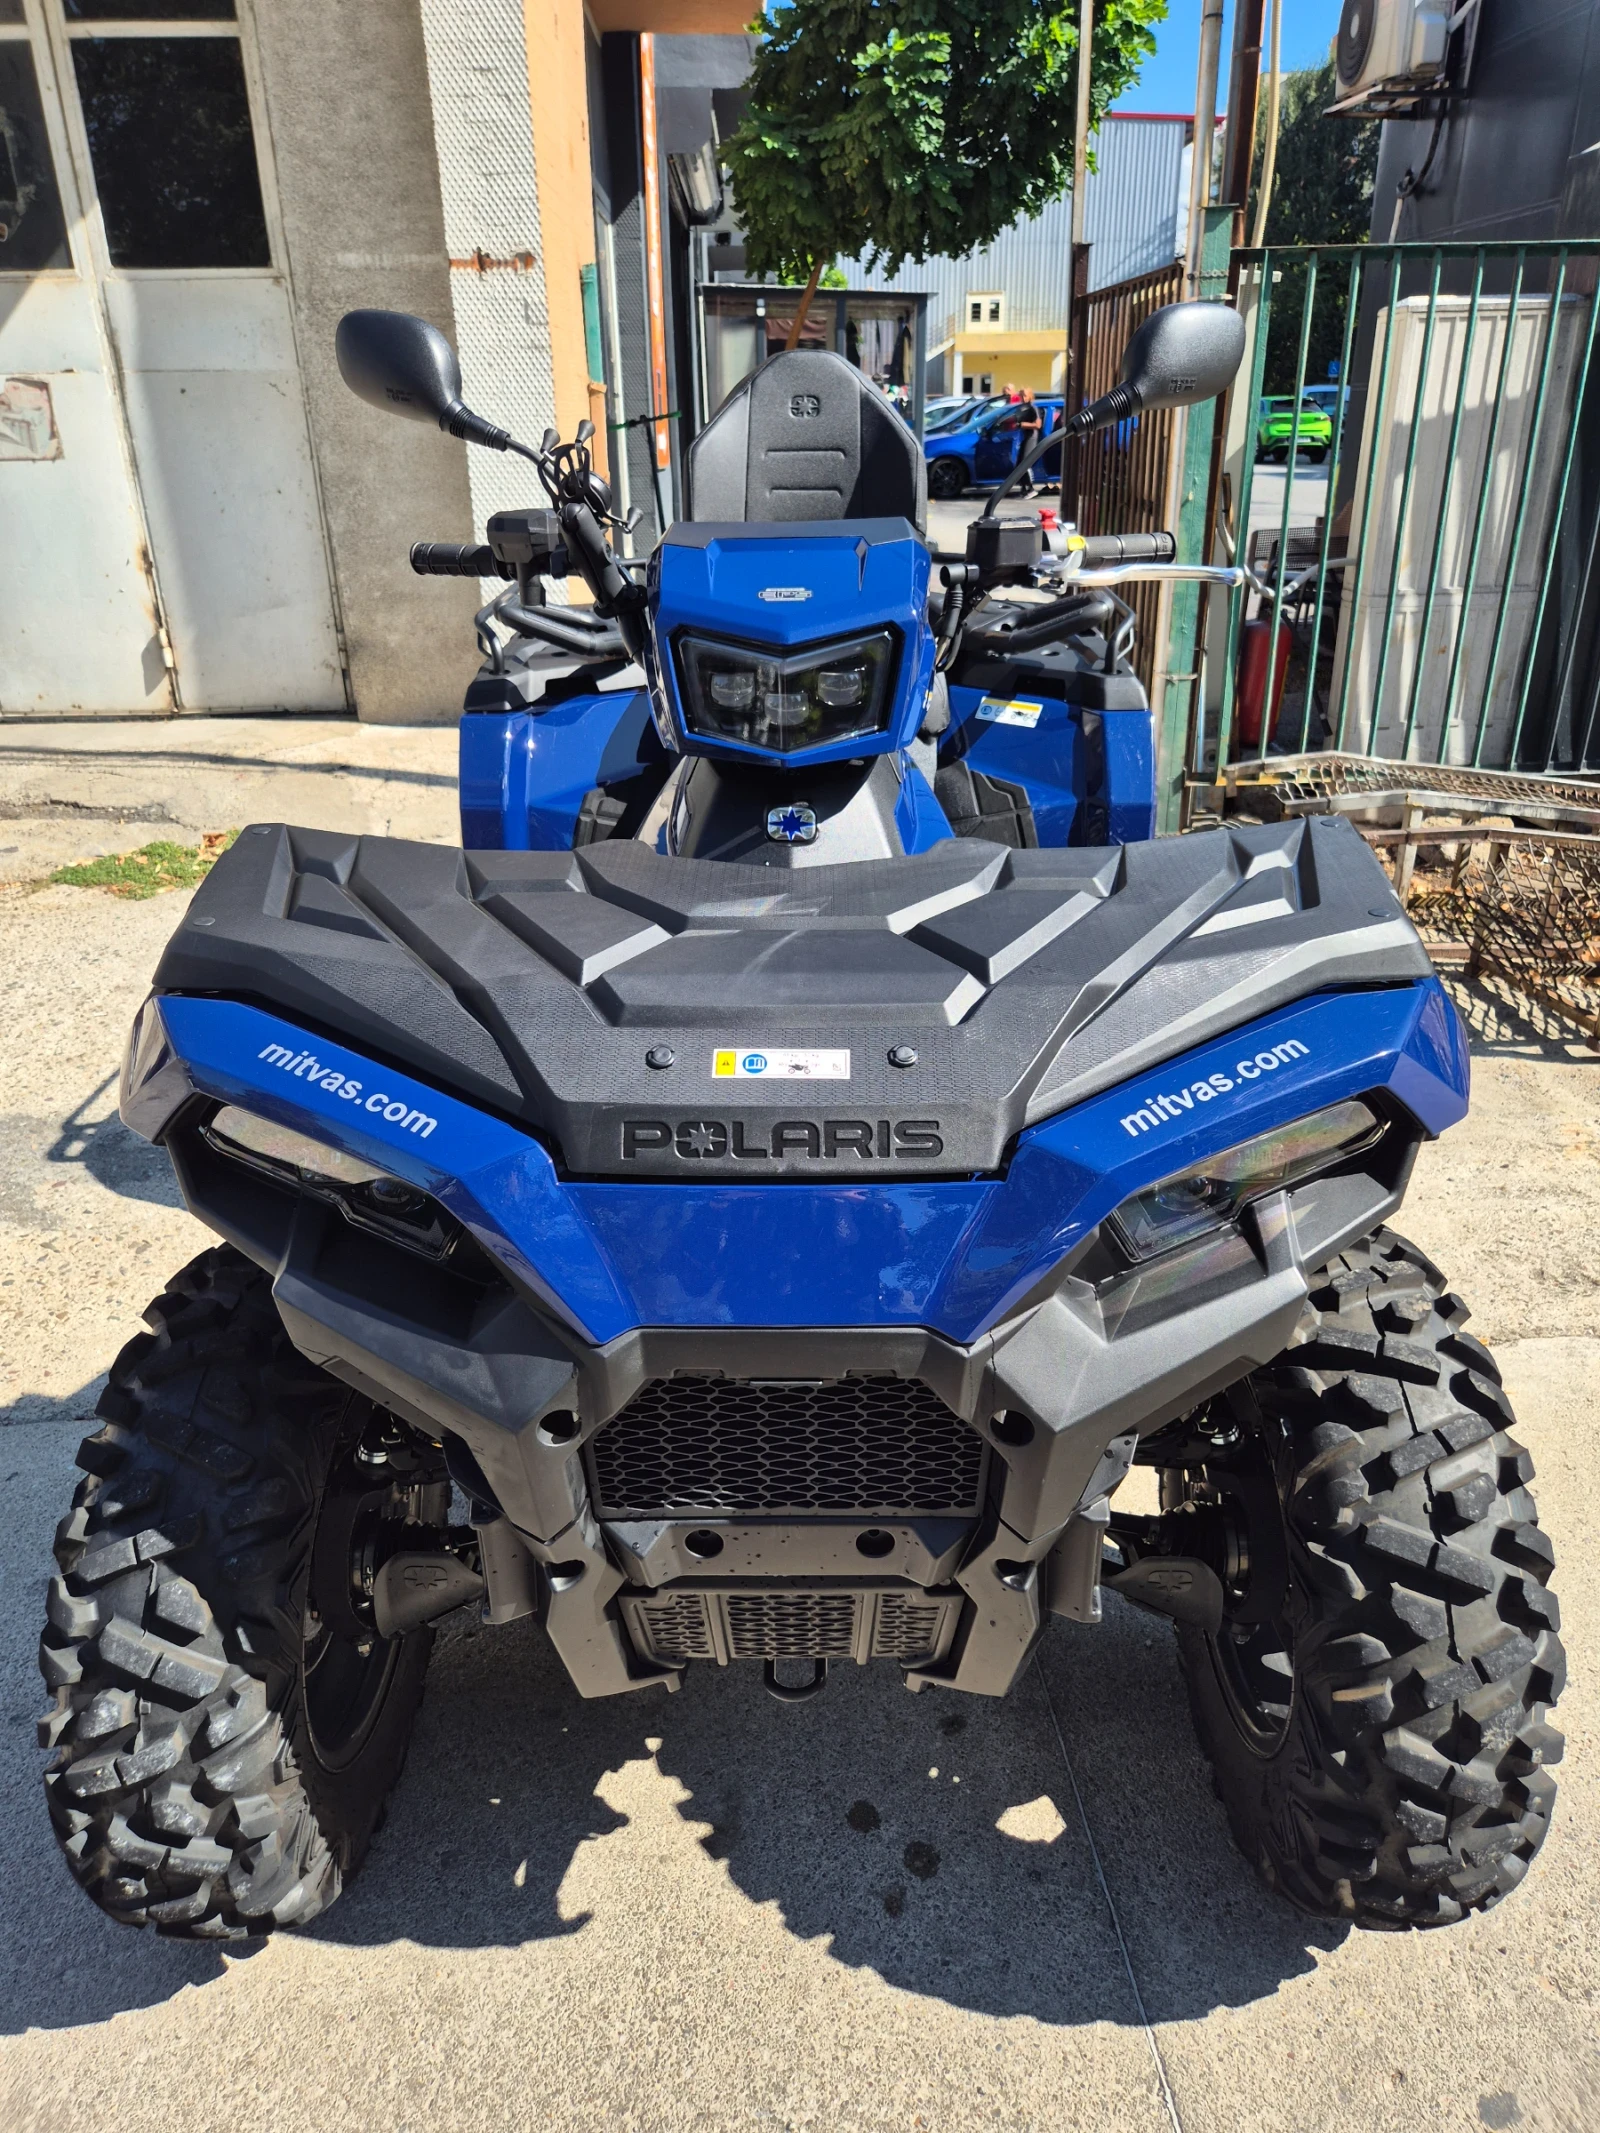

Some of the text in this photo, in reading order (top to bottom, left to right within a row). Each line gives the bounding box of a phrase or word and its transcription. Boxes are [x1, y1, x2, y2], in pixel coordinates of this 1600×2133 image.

[257, 1042, 438, 1139] mitvas.com
[1119, 1039, 1310, 1137] mitvas.com
[621, 1120, 944, 1159] POLARIS
